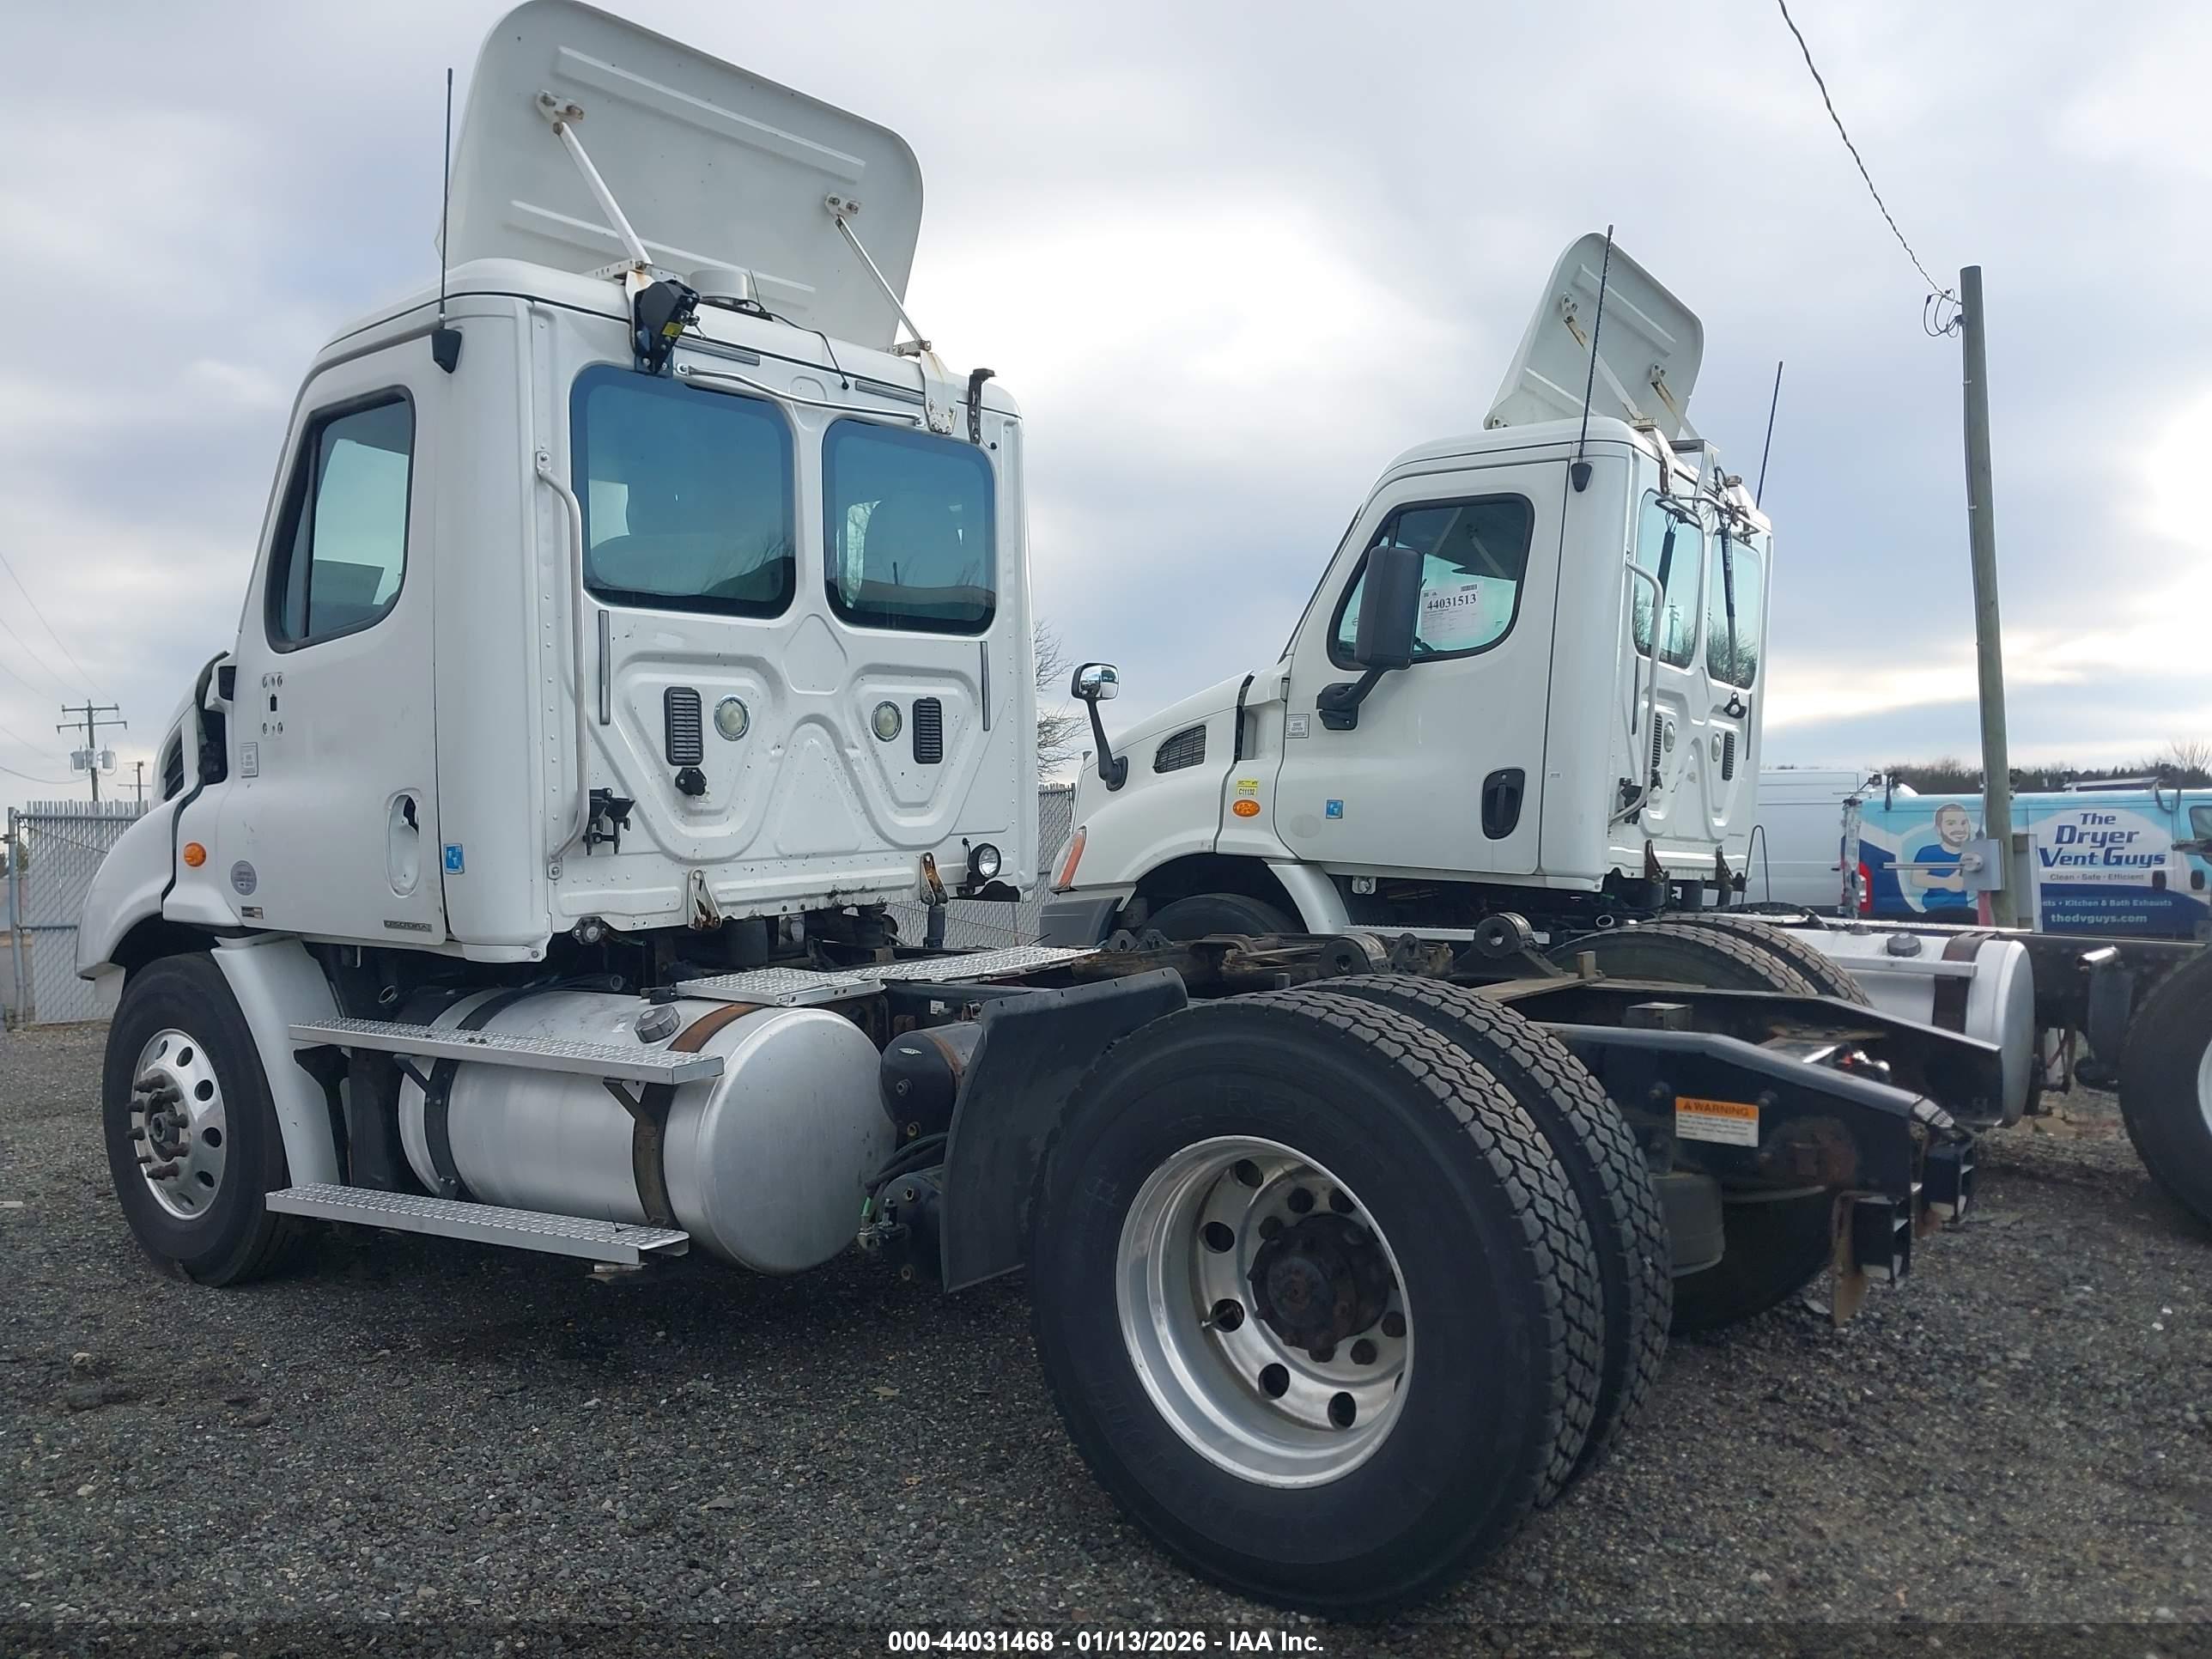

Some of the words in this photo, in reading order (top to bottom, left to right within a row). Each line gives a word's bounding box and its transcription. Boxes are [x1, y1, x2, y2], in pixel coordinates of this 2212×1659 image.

[1426, 593, 1476, 610] 44031513
[2080, 812, 2117, 825] The
[2055, 824, 2140, 848] Dryer
[2039, 847, 2100, 867] Vent
[2103, 847, 2166, 868] Guys
[1693, 1101, 1749, 1116] WARNING
